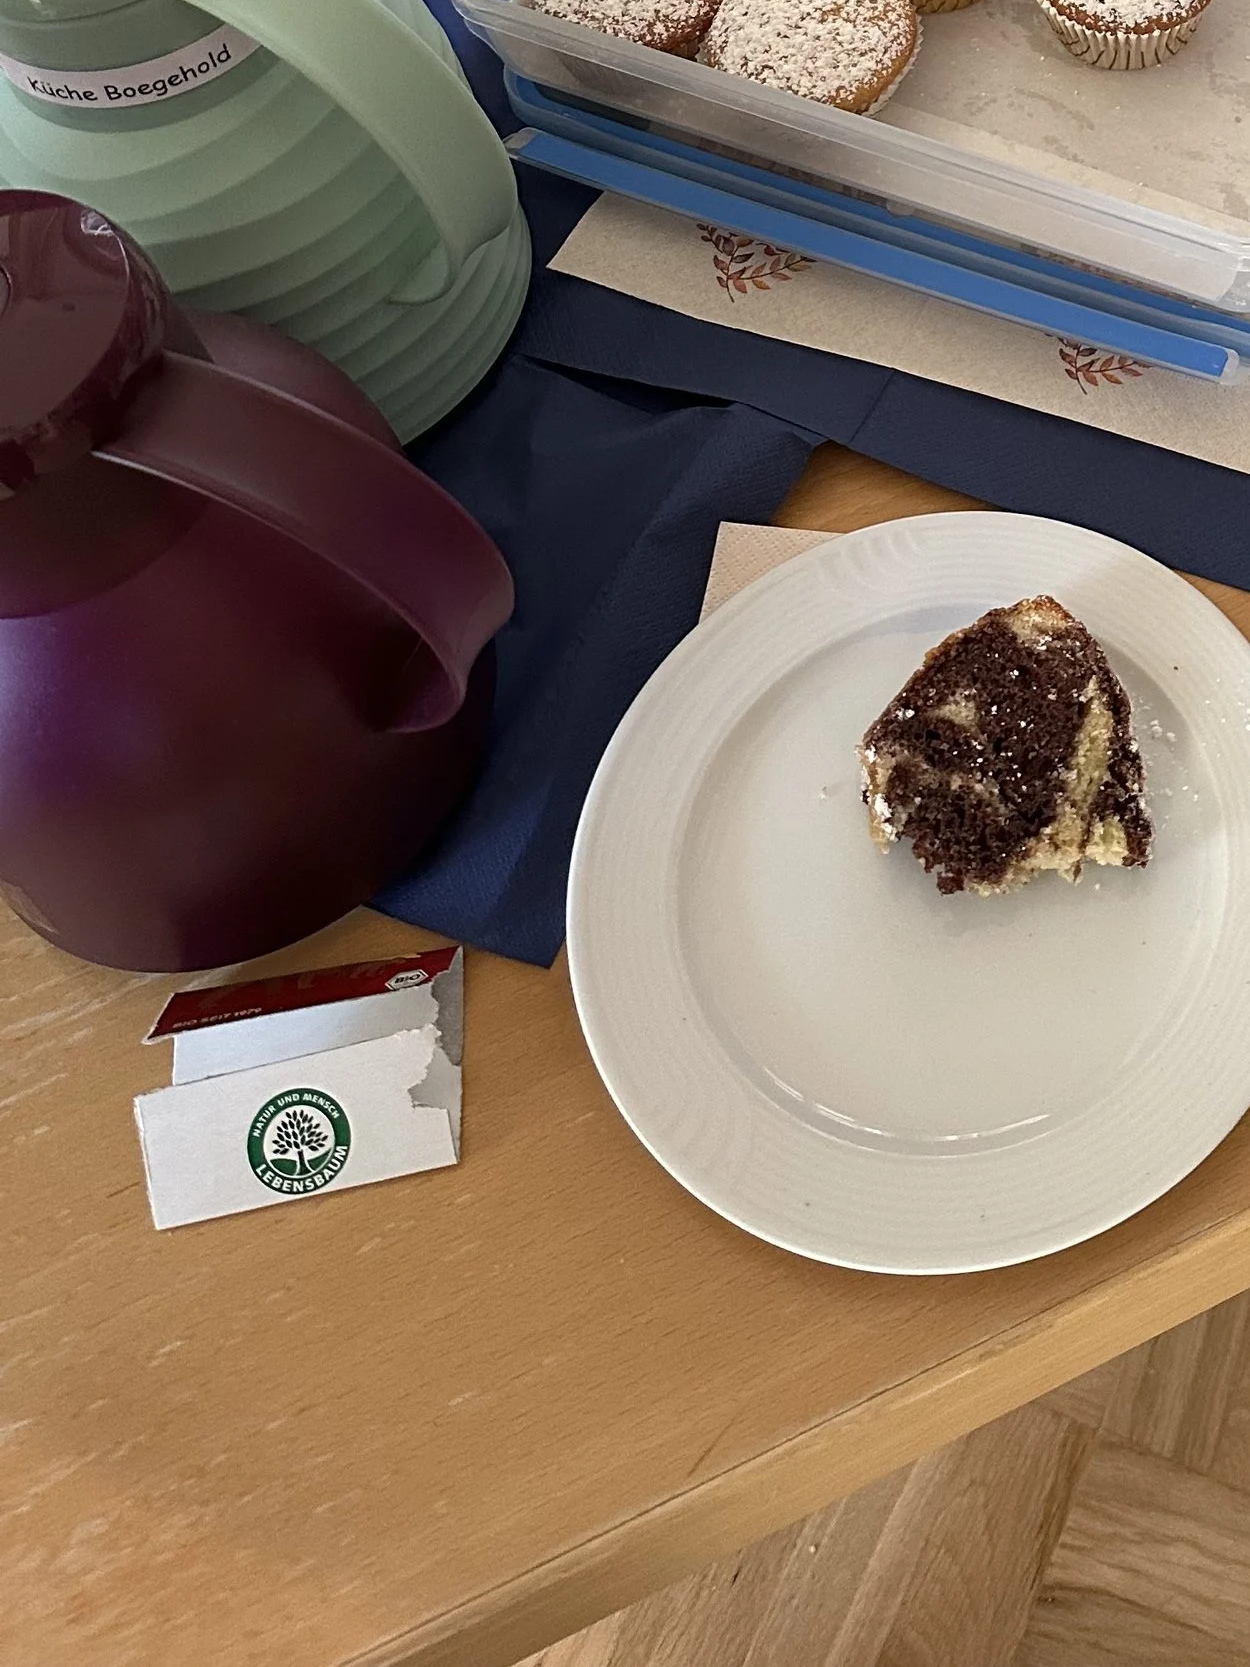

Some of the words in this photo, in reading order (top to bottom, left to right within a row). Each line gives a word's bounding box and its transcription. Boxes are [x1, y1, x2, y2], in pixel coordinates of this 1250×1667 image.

[27, 75, 98, 102] Küche
[103, 43, 232, 102] Boegehold
[252, 1105, 276, 1137] NATUR
[277, 1093, 300, 1107] UND
[302, 1093, 340, 1119] MENSCH
[255, 1145, 348, 1192] LEBENSBAUM
